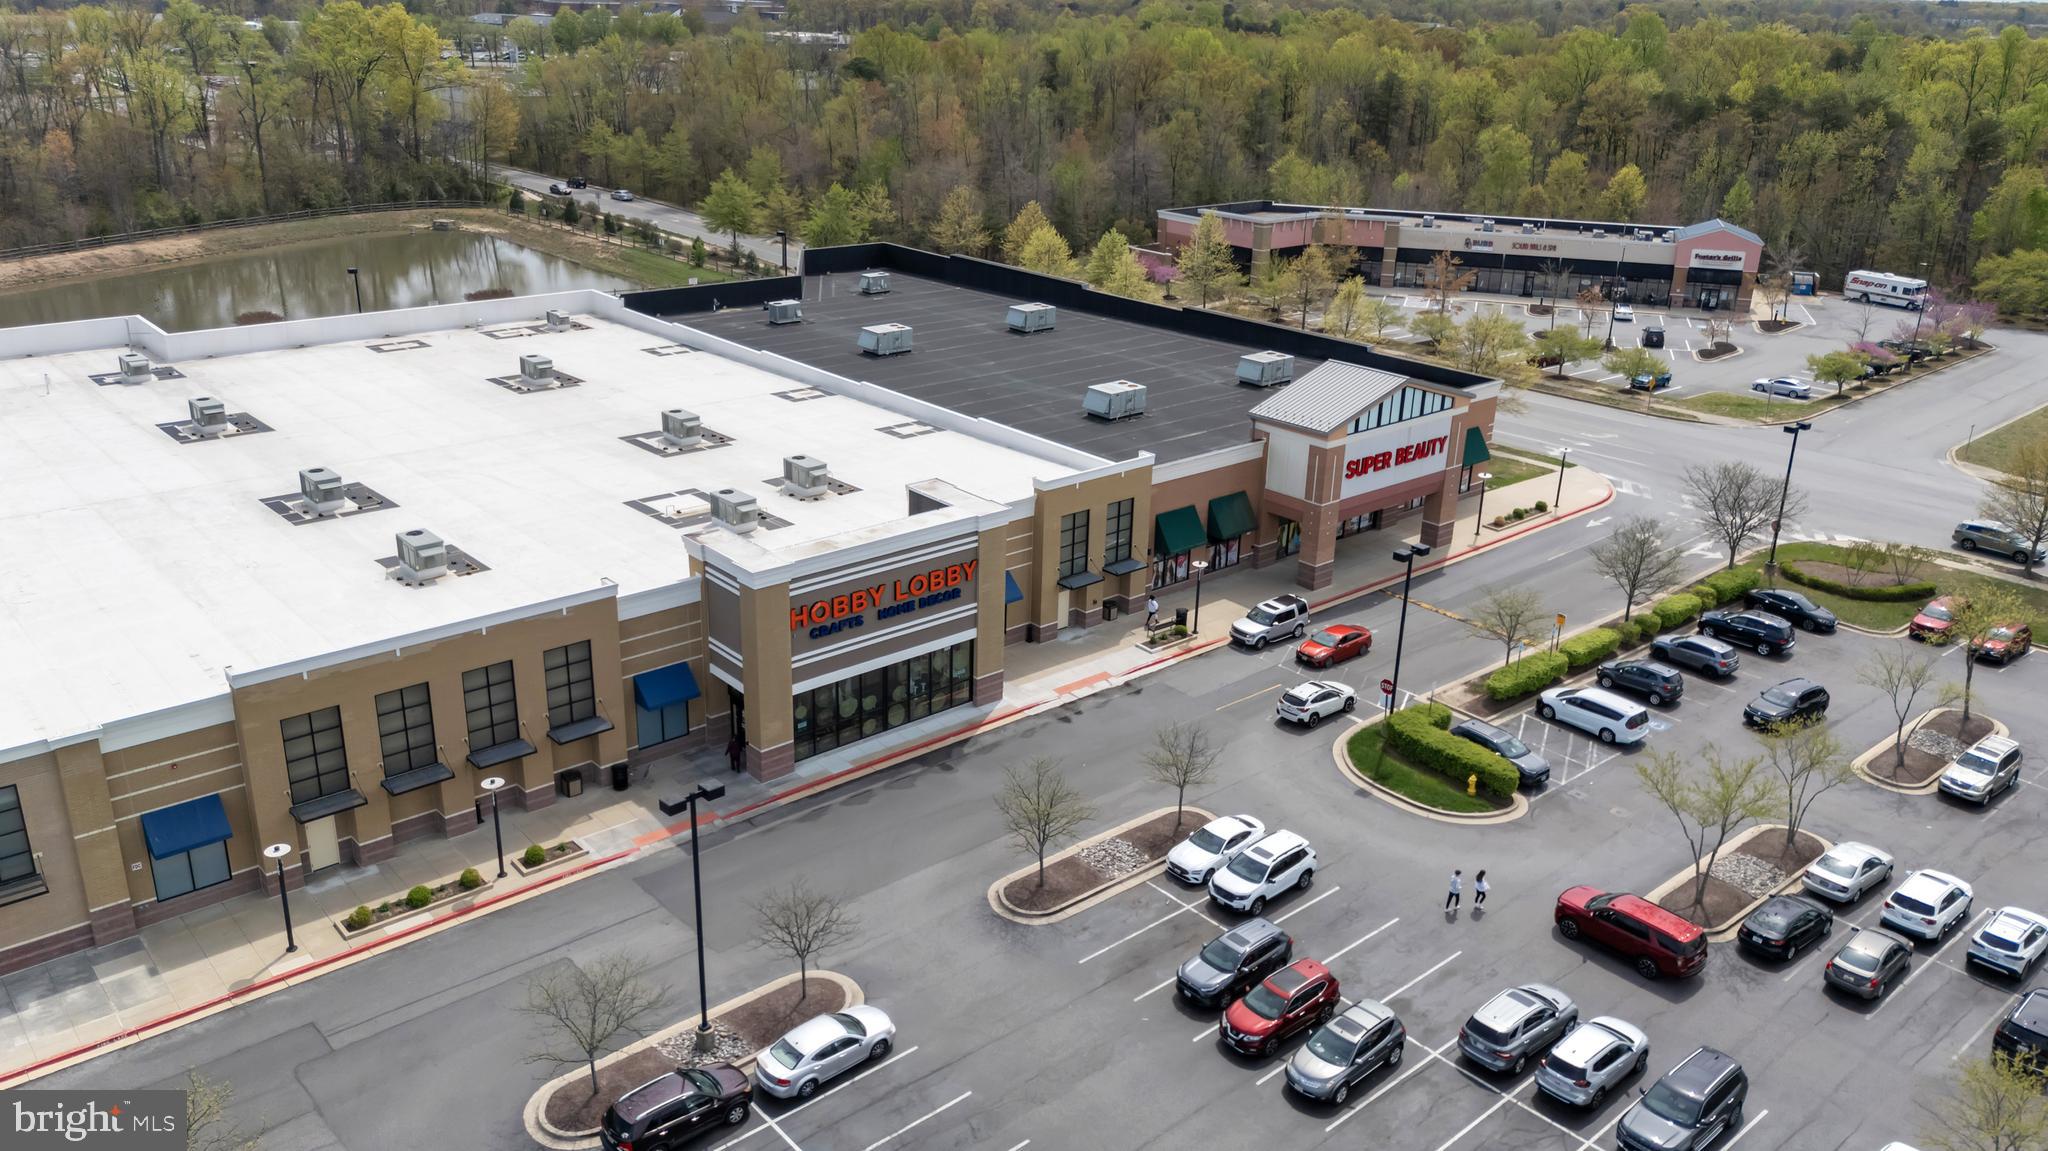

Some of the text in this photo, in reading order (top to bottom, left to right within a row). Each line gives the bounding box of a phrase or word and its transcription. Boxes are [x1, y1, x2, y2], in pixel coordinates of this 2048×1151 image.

[1850, 277, 1888, 289] Snap-on
[1345, 436, 1448, 479] SUPER BEAUTY
[790, 559, 978, 631] HOBBY LOBBY
[809, 587, 961, 640] CRAFTS HOME DECOR
